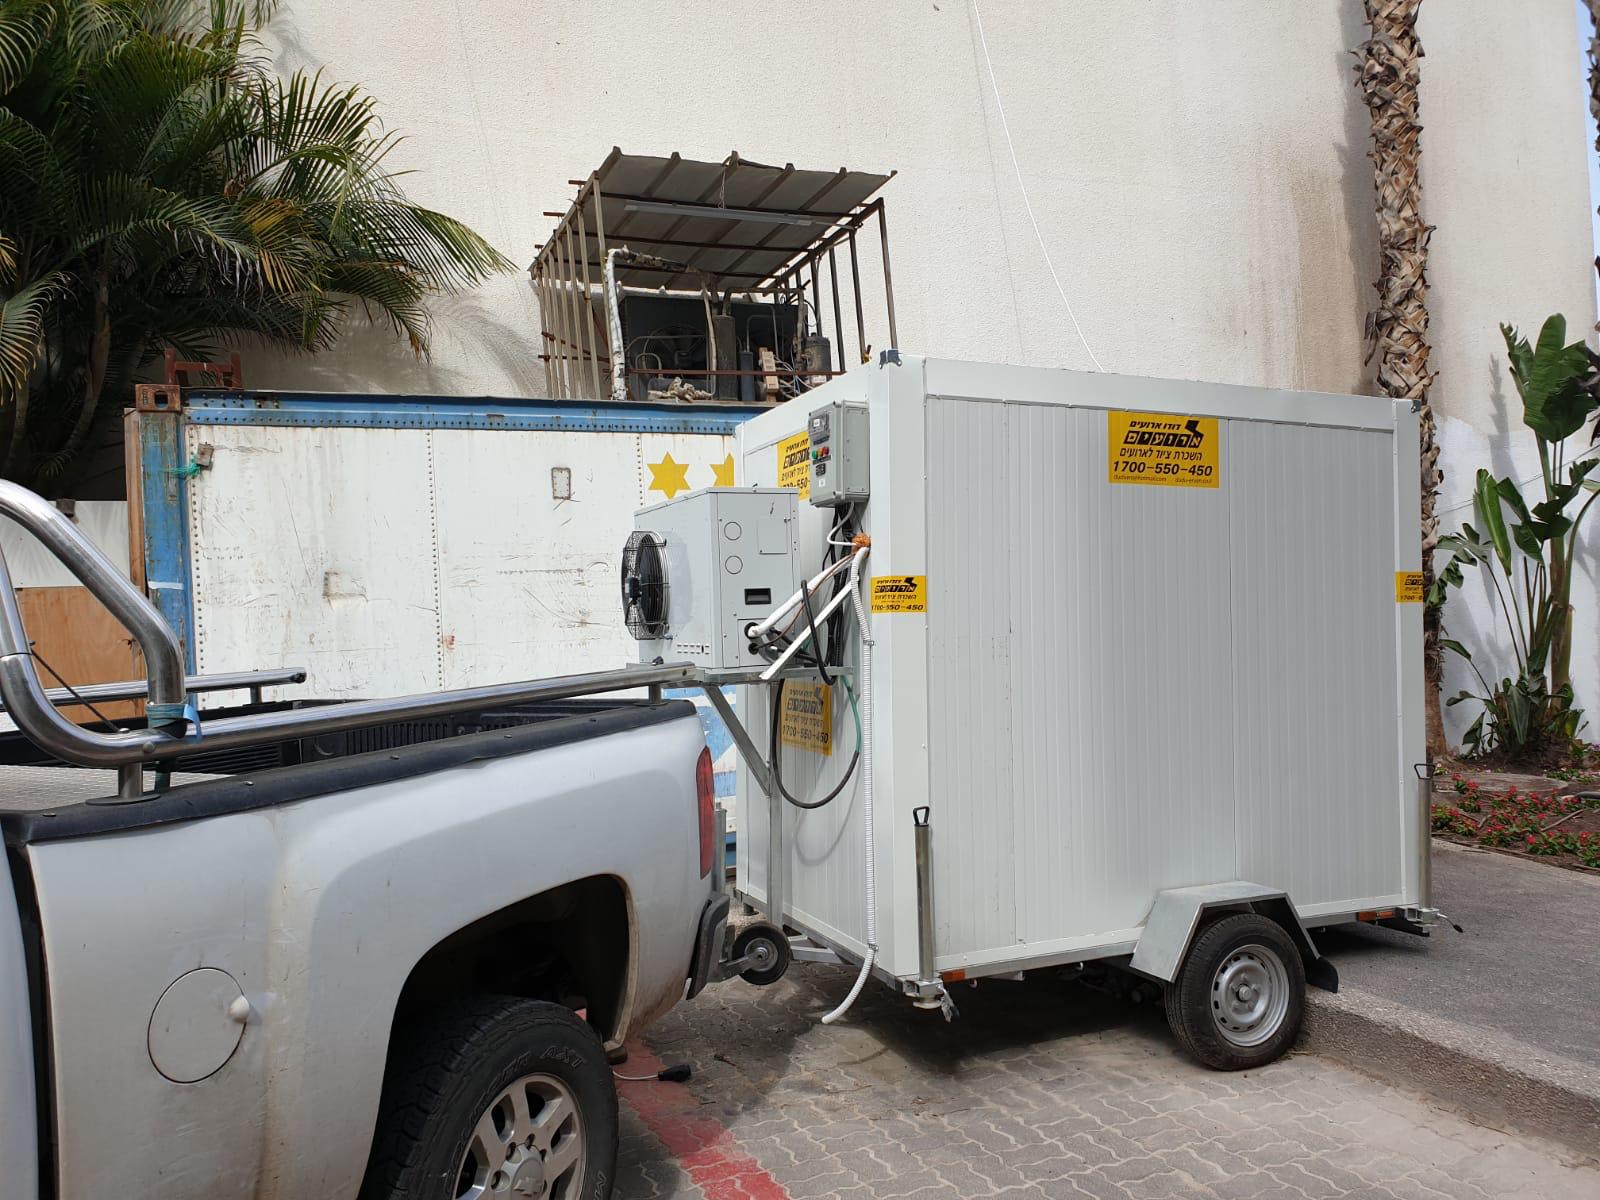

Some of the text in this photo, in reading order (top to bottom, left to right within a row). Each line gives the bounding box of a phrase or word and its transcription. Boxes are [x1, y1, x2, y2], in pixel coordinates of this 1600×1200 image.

[1129, 421, 1182, 431] דודו ארועים
[1123, 430, 1204, 448] ארועים
[1119, 447, 1203, 461] השכרת ציוד לארועים
[1113, 460, 1213, 477] 1700-550-450
